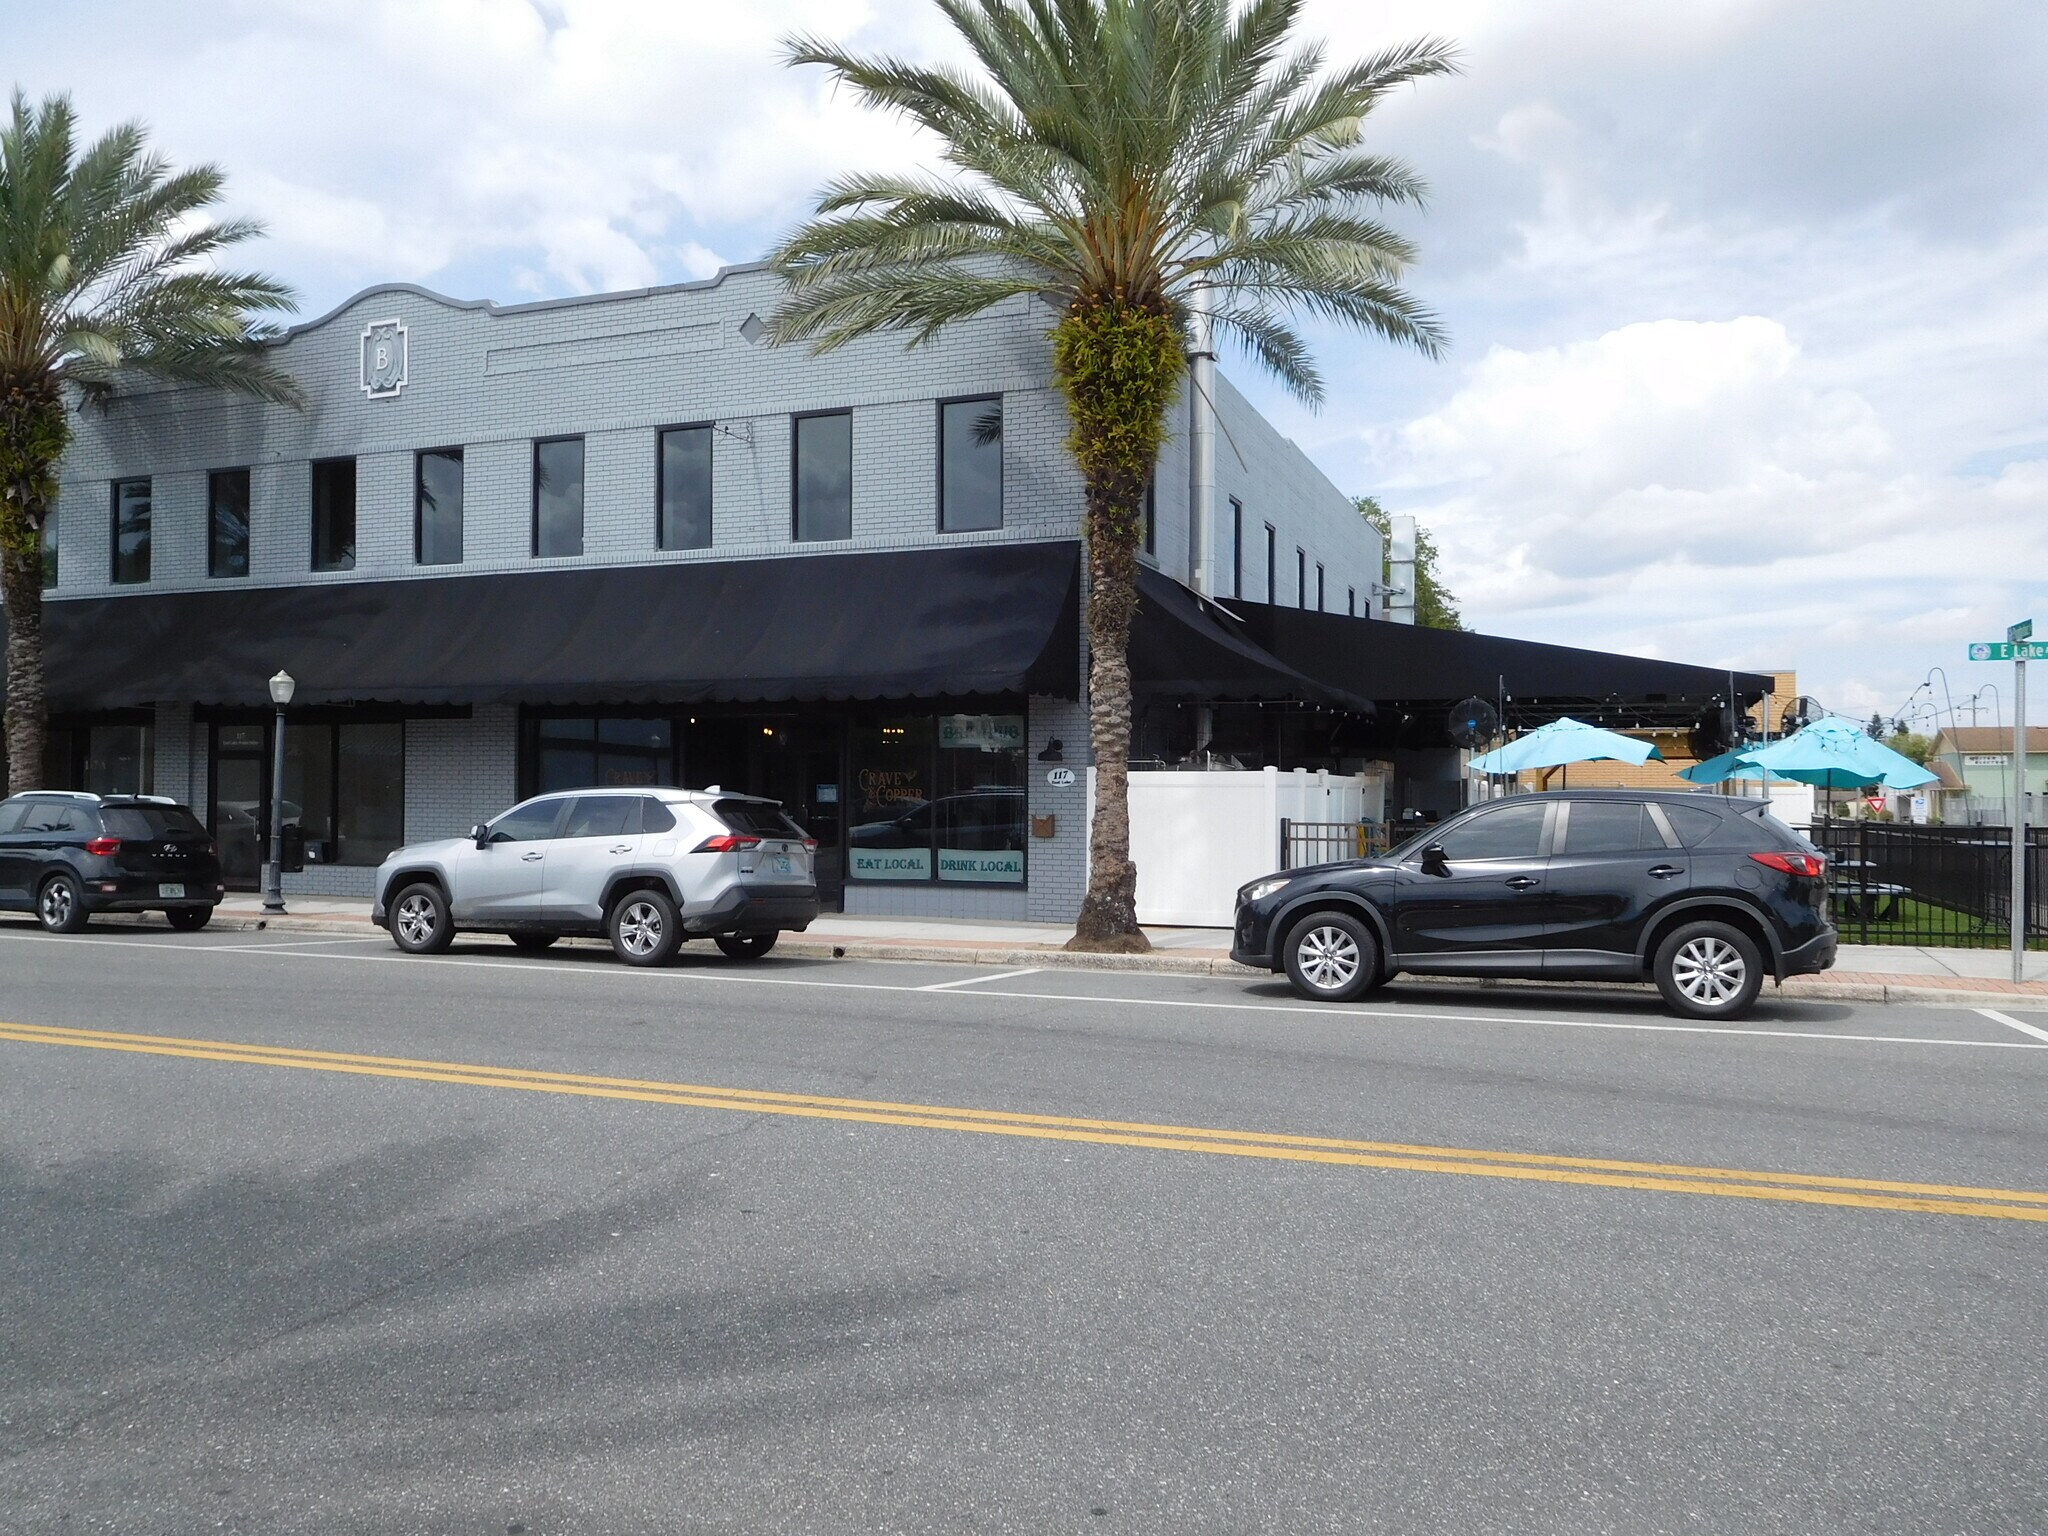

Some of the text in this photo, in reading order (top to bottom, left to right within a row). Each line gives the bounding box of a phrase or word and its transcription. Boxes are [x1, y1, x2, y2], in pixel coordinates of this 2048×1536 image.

[376, 348, 389, 370] B
[2001, 645, 2009, 658] E
[2014, 644, 2044, 657] Lake
[859, 768, 902, 791] CRAVE
[1054, 770, 1069, 780] 117
[857, 858, 924, 870] EAT LOCAL
[940, 859, 1022, 873] DRINK LOCAL
